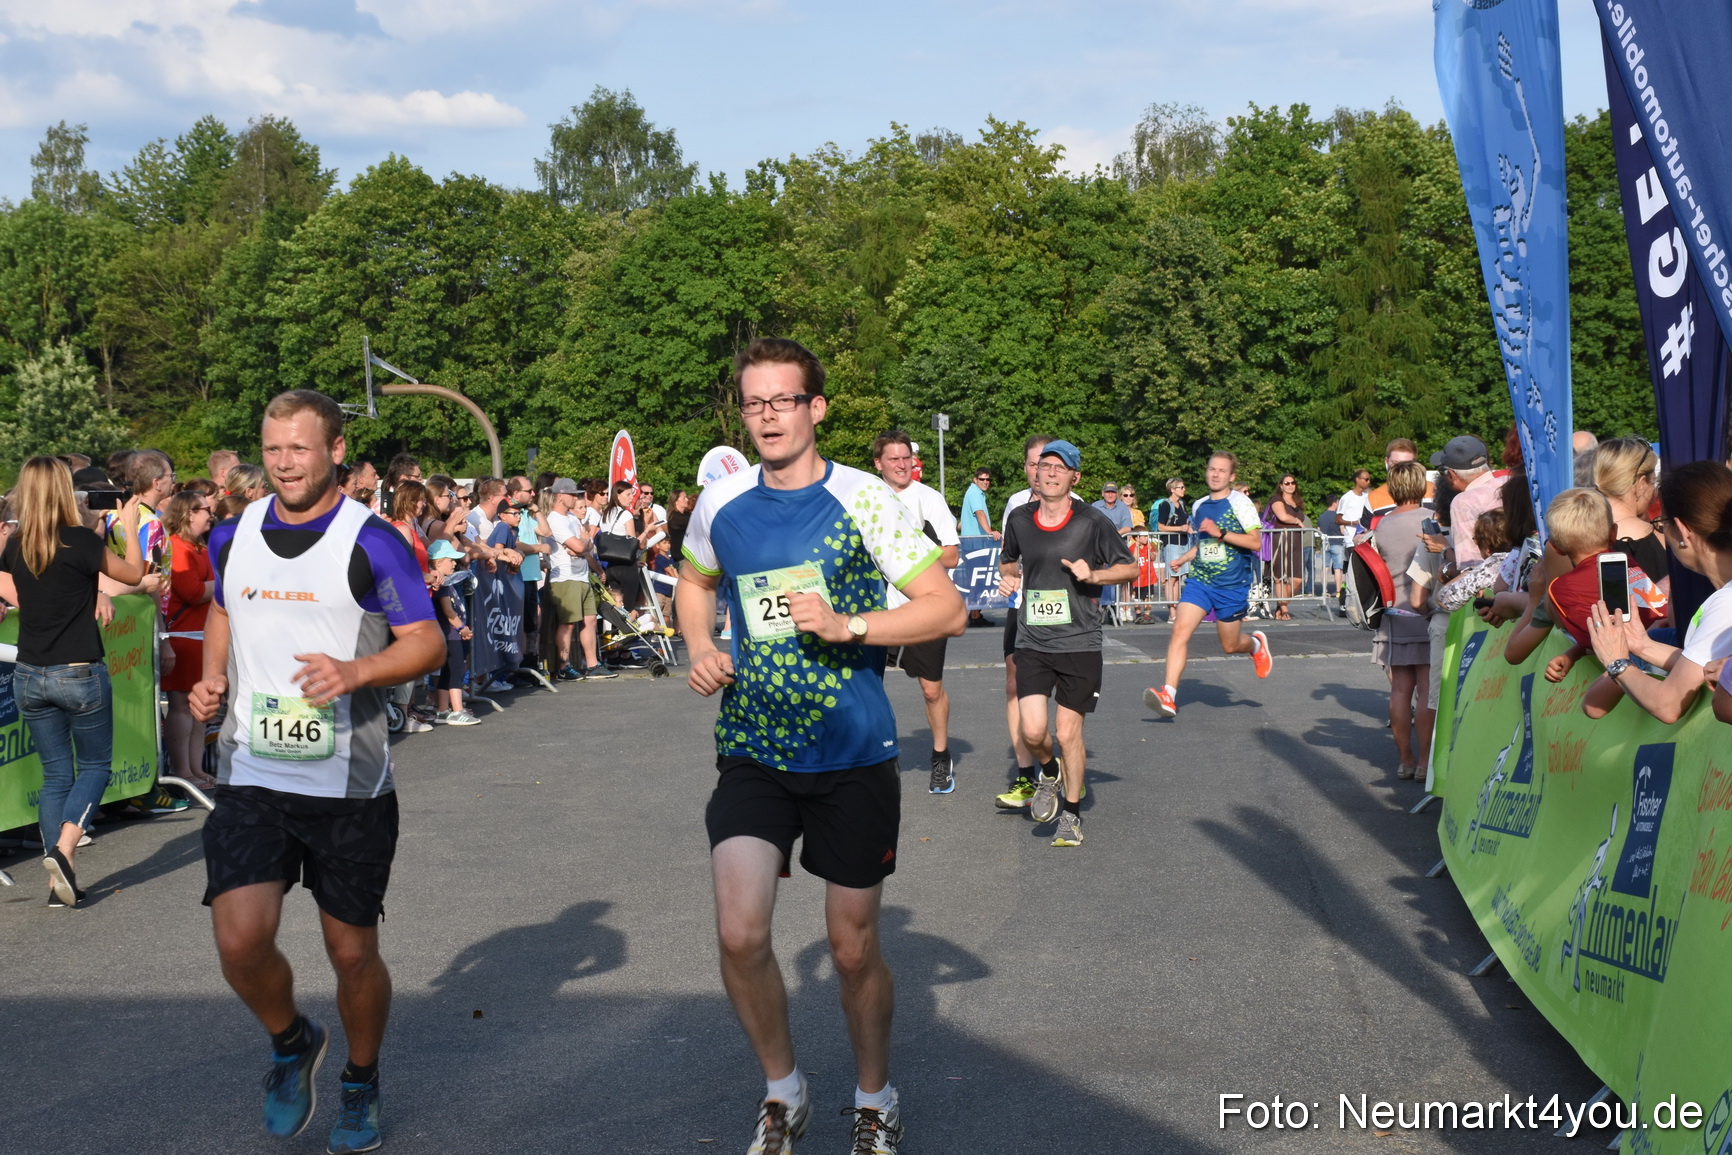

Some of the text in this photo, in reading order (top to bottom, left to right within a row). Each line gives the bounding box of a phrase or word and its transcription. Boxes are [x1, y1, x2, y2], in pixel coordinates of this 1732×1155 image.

[1204, 546, 1218, 556] 240
[261, 590, 319, 602] KLEBL
[759, 592, 804, 621] 25
[1031, 602, 1063, 616] 1492
[260, 716, 321, 743] 1146
[284, 741, 309, 749] Markus
[1636, 790, 1663, 817] Fischer
[1585, 969, 1625, 1004] neumarkt
